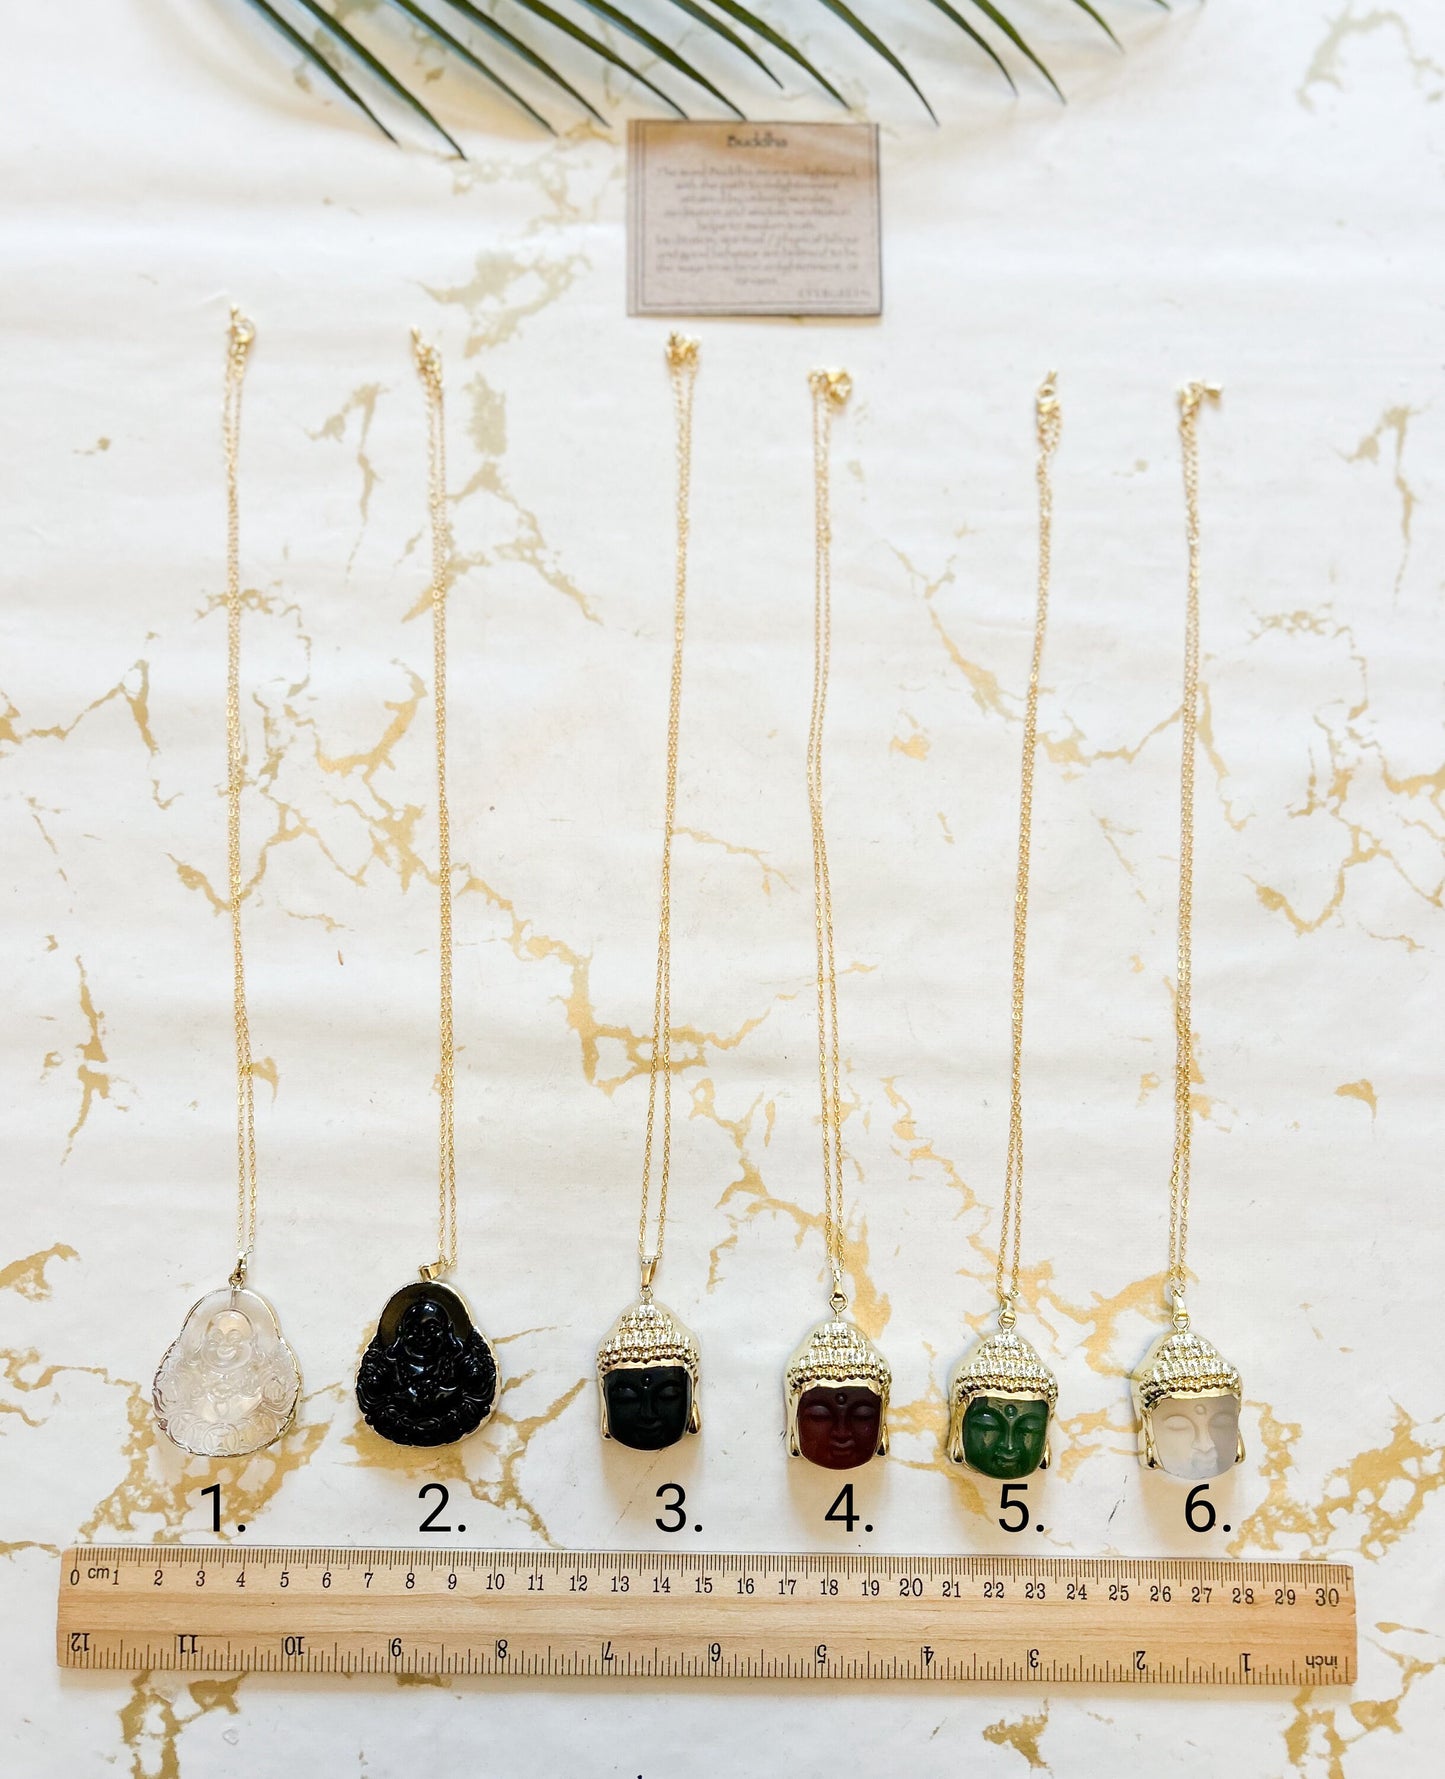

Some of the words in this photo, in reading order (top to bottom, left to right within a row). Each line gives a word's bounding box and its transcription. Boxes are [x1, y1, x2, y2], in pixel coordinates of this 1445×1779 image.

[726, 131, 788, 149] Buddha
[69, 1569, 80, 1585] 0
[88, 1568, 110, 1579] cm
[112, 1569, 120, 1585] 1
[153, 1570, 163, 1586] 2
[195, 1570, 206, 1587] 3
[236, 1571, 246, 1587] 4
[280, 1571, 289, 1588] 5
[321, 1572, 332, 1588] 6
[364, 1572, 374, 1588] 7
[405, 1572, 416, 1589] 8
[447, 1573, 457, 1589] 9
[486, 1573, 505, 1590] 10
[527, 1574, 544, 1590] 11
[569, 1575, 588, 1591] 12
[610, 1575, 630, 1592] 13
[652, 1576, 671, 1593] 14
[694, 1577, 713, 1593] 15
[736, 1577, 755, 1594] 16
[778, 1579, 797, 1595] 17
[820, 1579, 839, 1595] 18
[861, 1580, 880, 1596] 19
[899, 1578, 923, 1597] 20
[942, 1581, 961, 1598] 21
[983, 1582, 1005, 1599] 22
[1025, 1582, 1046, 1600] 23
[1066, 1583, 1088, 1600] 24
[1108, 1584, 1130, 1601] 25
[1150, 1585, 1172, 1602] 26
[1191, 1586, 1212, 1603] 27
[1232, 1587, 1255, 1605] 28
[1274, 1588, 1296, 1606] 29
[1315, 1587, 1340, 1607] 30
[70, 1632, 90, 1652] 12
[177, 1634, 199, 1655] 11
[284, 1636, 305, 1656] 10
[391, 1637, 402, 1657] 9
[497, 1639, 508, 1659] 8
[603, 1641, 614, 1661] 7
[710, 1642, 721, 1662] 6
[816, 1644, 827, 1664] 5
[923, 1645, 934, 1666] 4
[1029, 1649, 1039, 1669] 3
[1135, 1650, 1146, 1670] 2
[1241, 1653, 1252, 1672] 1
[1305, 1655, 1338, 1669] inch
